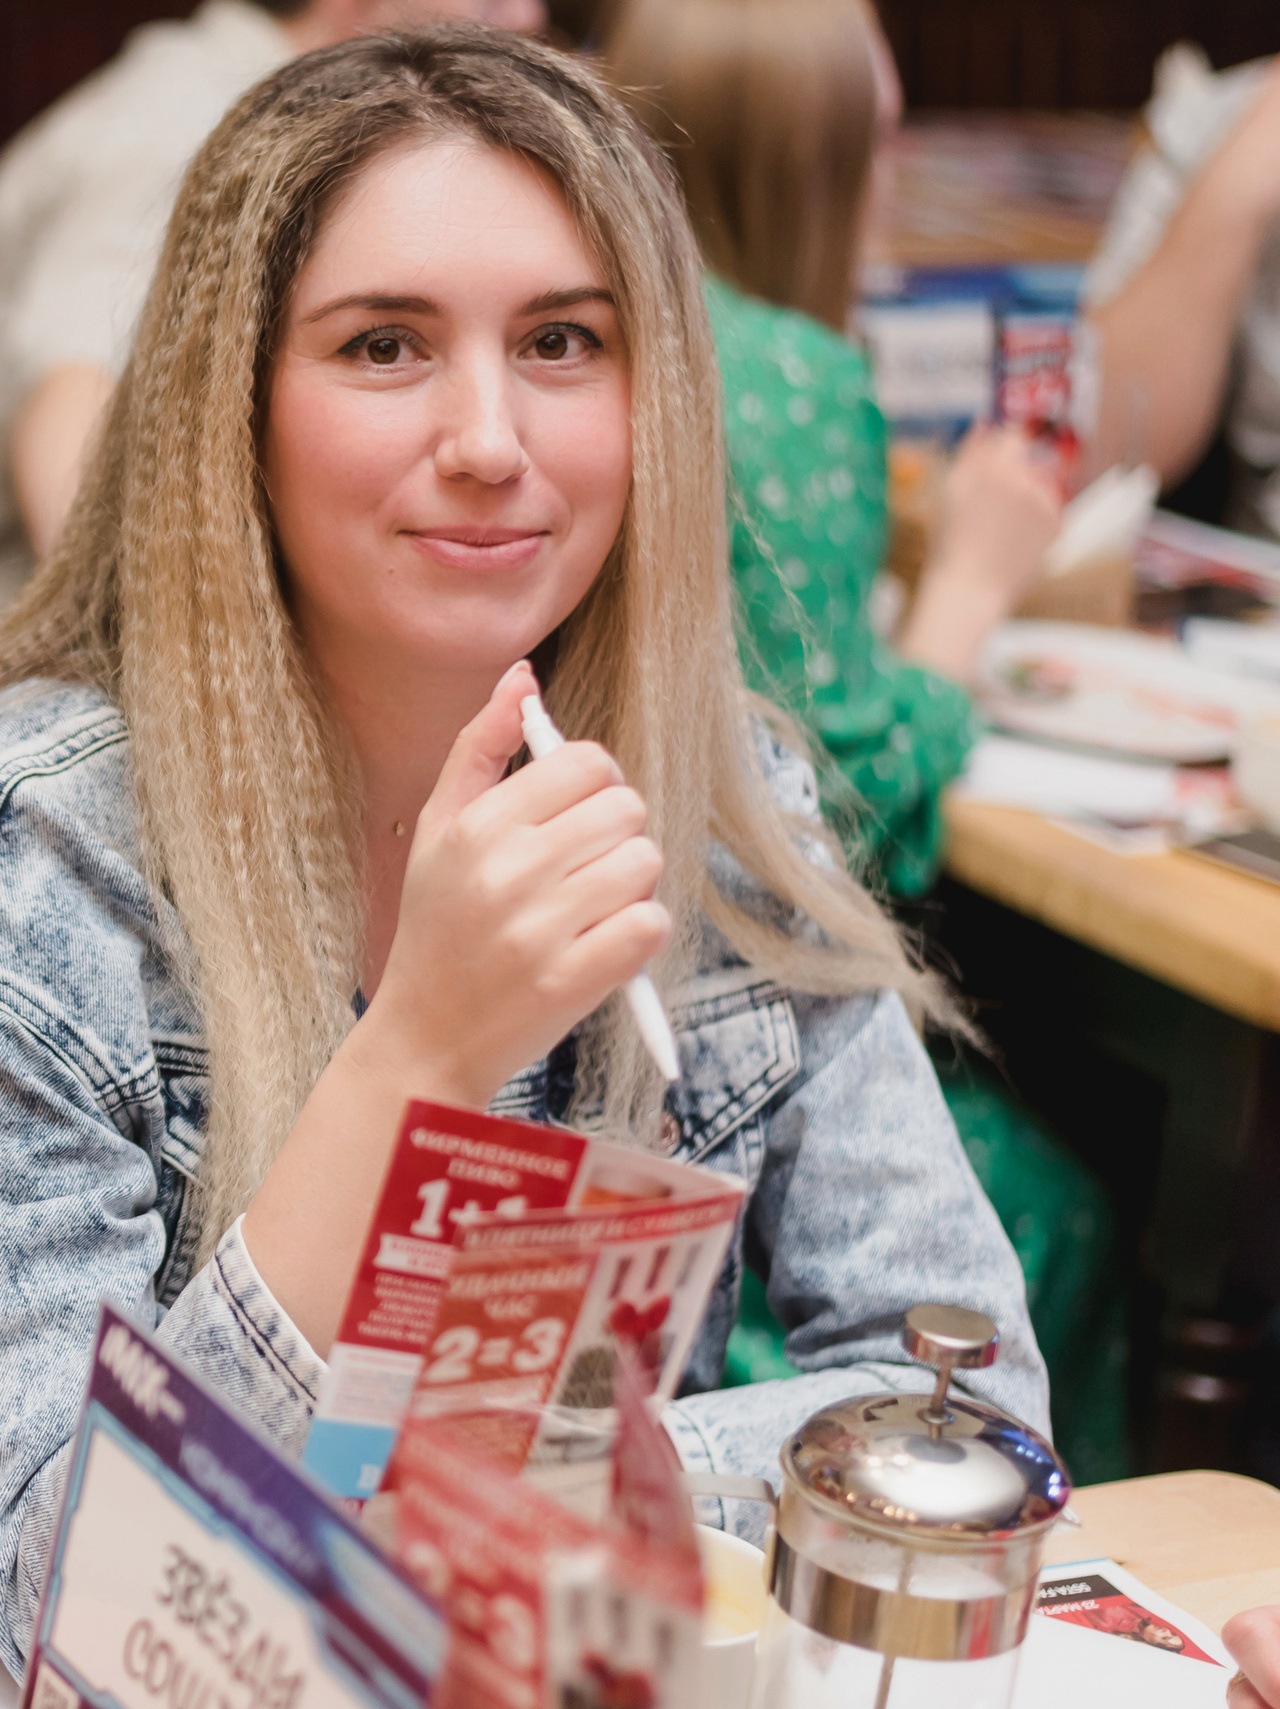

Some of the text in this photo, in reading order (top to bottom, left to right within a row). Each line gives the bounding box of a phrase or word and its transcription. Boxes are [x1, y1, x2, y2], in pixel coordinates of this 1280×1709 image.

[410, 1127, 569, 1181] ФИРМЕННОЕ
[448, 1157, 520, 1190] ПИВО
[424, 1317, 566, 1382] 2=3
